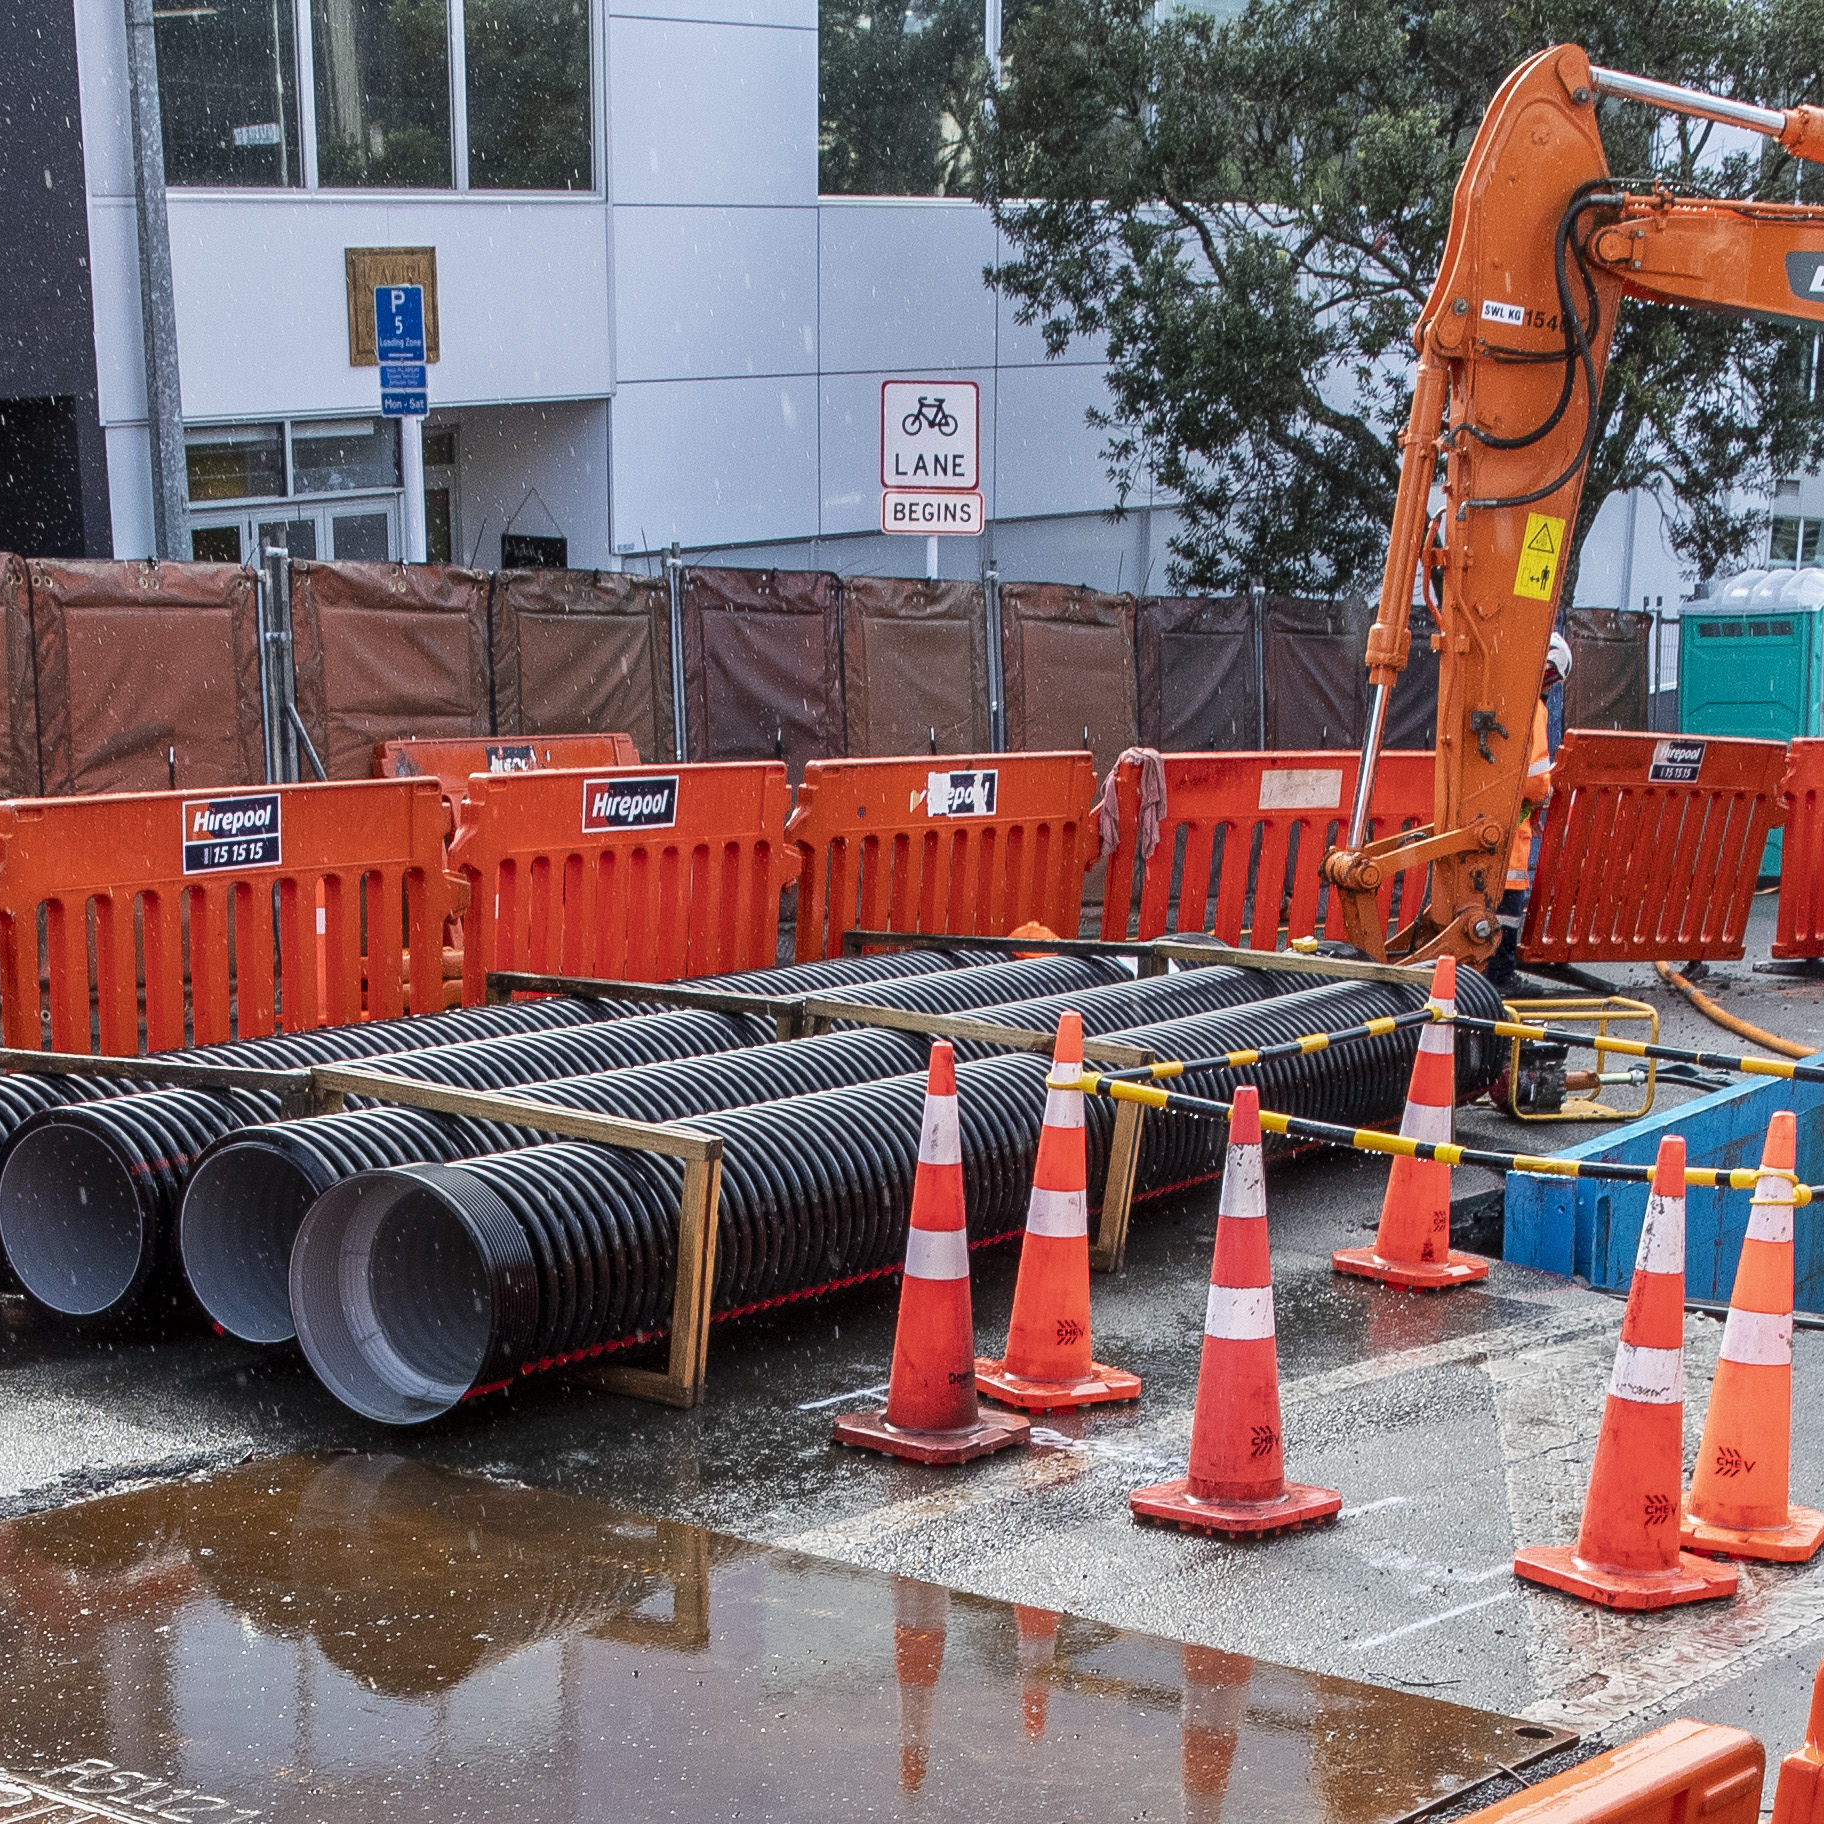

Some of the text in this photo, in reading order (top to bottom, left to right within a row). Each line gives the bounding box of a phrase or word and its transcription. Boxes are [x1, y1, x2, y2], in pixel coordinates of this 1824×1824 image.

[391, 290, 405, 313] P
[1485, 304, 1521, 320] SWL KG
[394, 316, 403, 334] 5
[1525, 309, 1565, 334] 154
[385, 397, 402, 409] Mon
[409, 398, 425, 410] Sat
[895, 453, 965, 476] LANE
[893, 502, 972, 522] BEGINS
[592, 789, 669, 822] Hirepool
[193, 804, 272, 834] Hirepool
[214, 846, 229, 863] 15
[232, 844, 247, 861] 15
[249, 842, 263, 859] 15
[1717, 1457, 1756, 1473] CHEV
